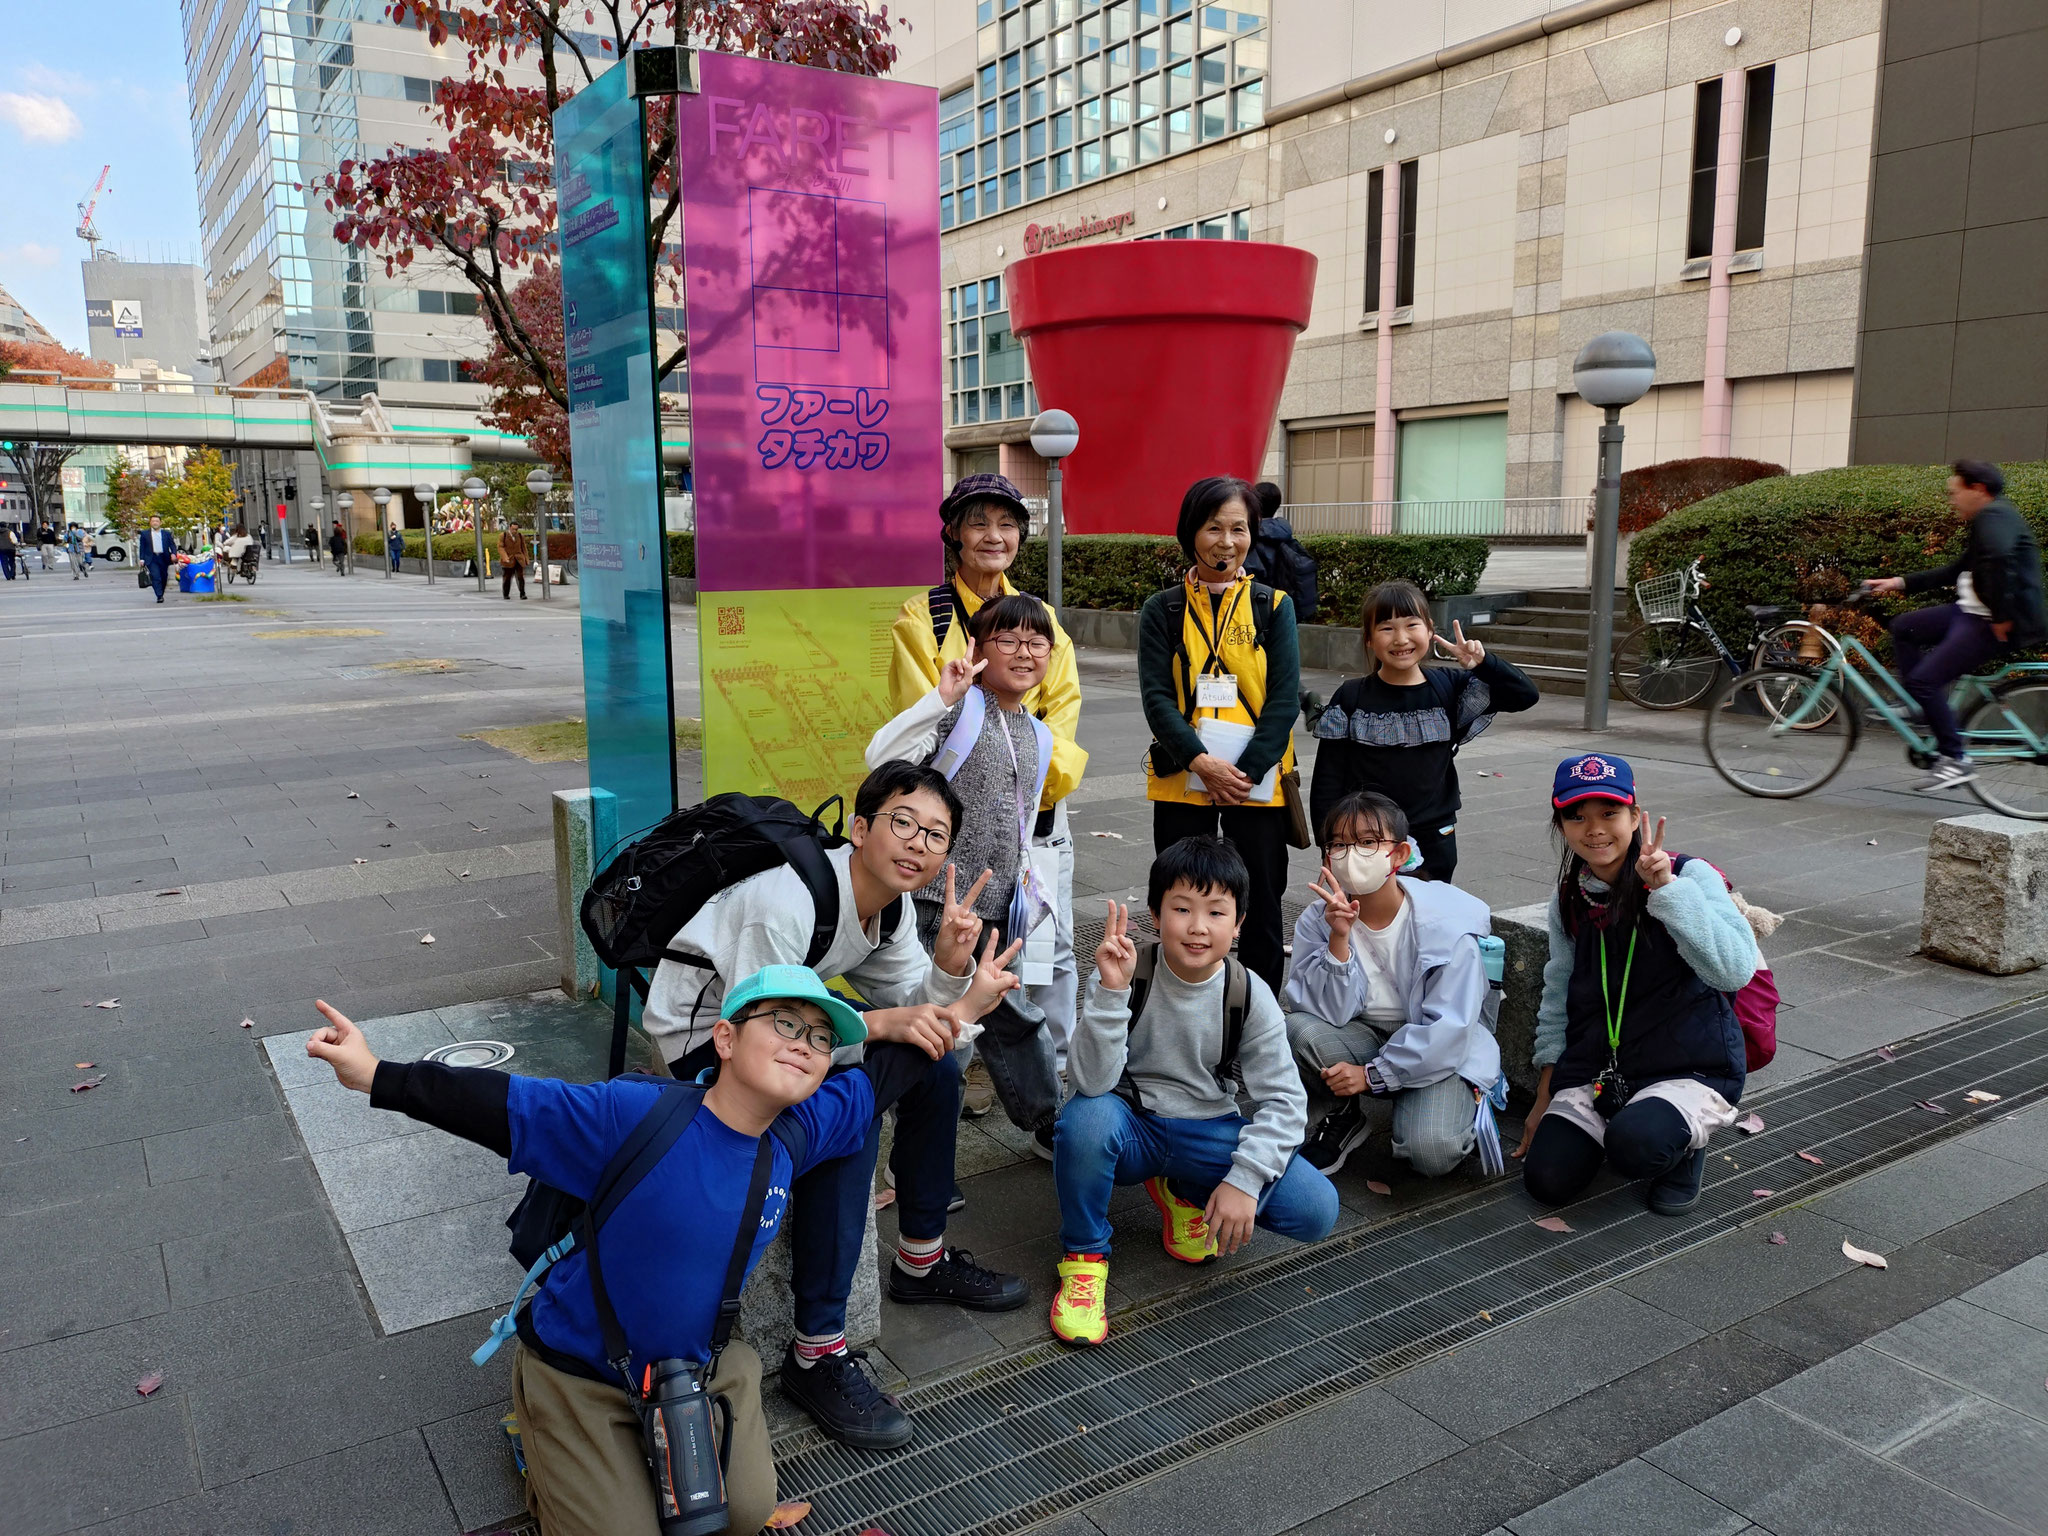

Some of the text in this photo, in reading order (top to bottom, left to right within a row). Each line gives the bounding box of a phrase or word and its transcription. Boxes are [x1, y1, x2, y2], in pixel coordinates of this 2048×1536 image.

[708, 95, 911, 180] FARET
[1042, 212, 1133, 246] Takashimaya
[88, 309, 112, 317] SYLA
[756, 385, 890, 429] ファーレ
[757, 428, 890, 470] タチカワ
[1227, 624, 1255, 636] FARE
[1227, 633, 1253, 645] CLU
[1201, 692, 1233, 702] Atsuko
